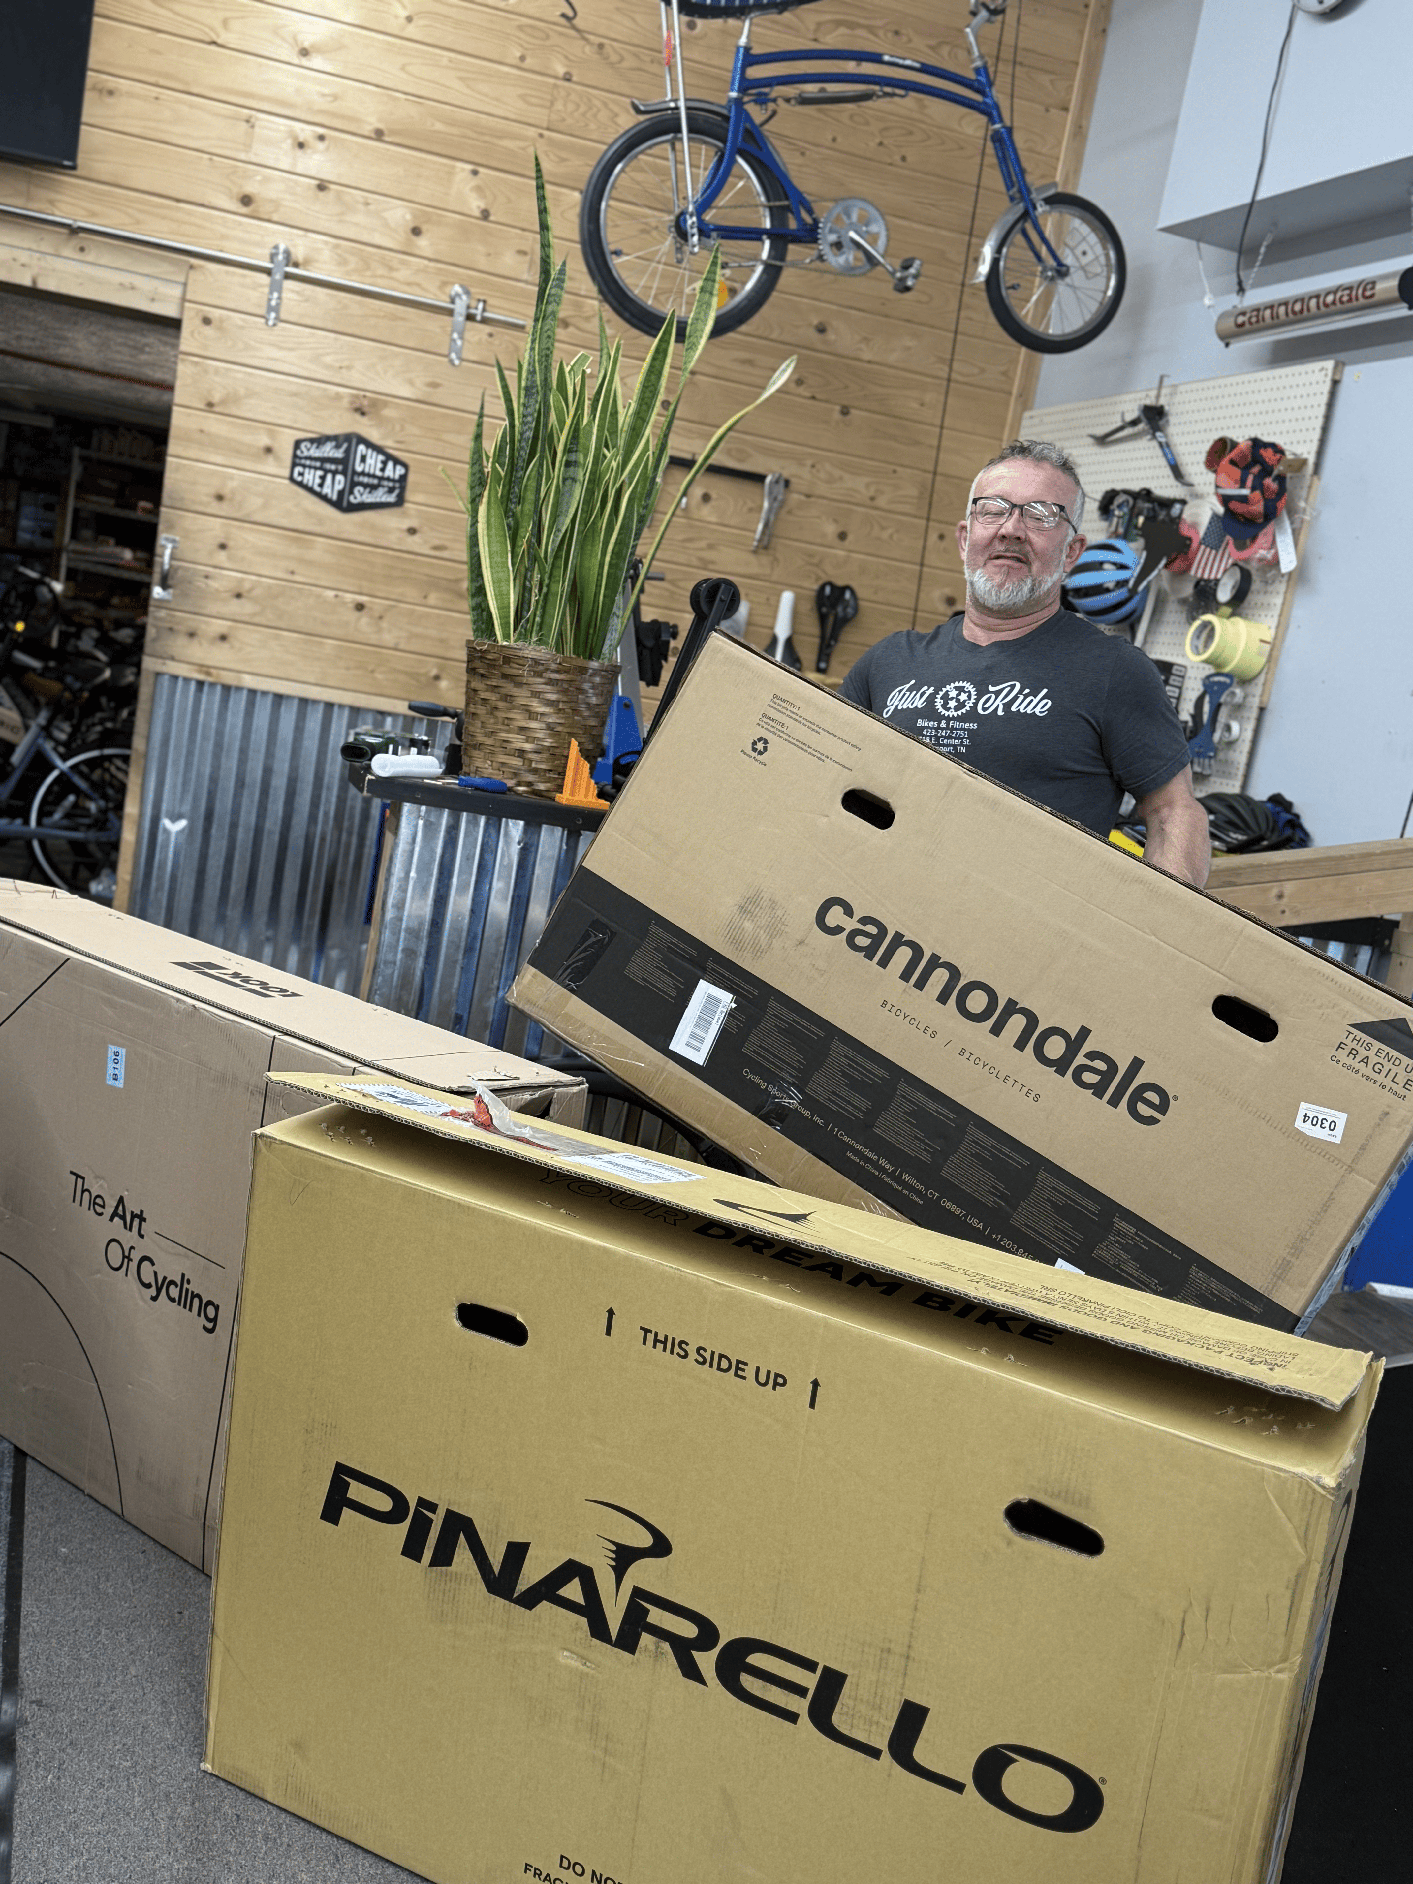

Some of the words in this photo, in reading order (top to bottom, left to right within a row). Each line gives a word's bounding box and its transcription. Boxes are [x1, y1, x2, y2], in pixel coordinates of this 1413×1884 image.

[1234, 279, 1376, 329] cannondale
[296, 441, 349, 458] Skilled
[355, 443, 406, 480] CHEAP
[293, 466, 345, 501] CHEAP
[349, 486, 400, 504] Skilled
[883, 680, 934, 718] Just
[977, 681, 1052, 716] Ride
[916, 718, 938, 728] Bikes
[939, 720, 947, 728] &
[949, 720, 978, 729] Fitness
[922, 729, 968, 738] 423-247-2751
[815, 896, 1171, 1127] cannondale
[880, 999, 938, 1039] BICYCLES
[958, 1047, 1041, 1103] BICYCLETTES
[1335, 1042, 1413, 1091] FRAGILE
[1344, 1030, 1373, 1052] THIS
[1374, 1047, 1402, 1067] END
[1404, 1063, 1413, 1074] U
[1330, 1054, 1341, 1065] Ce
[1361, 1072, 1378, 1085] vers
[1388, 1086, 1407, 1101] haut
[1302, 1112, 1337, 1132] 0304
[742, 1068, 767, 1089] Cycling
[767, 1084, 790, 1100] Sports
[837, 1130, 878, 1161] Cannondale
[879, 1156, 895, 1173] Way
[901, 1172, 925, 1194] Wilton,
[927, 1189, 940, 1200] CT
[966, 1214, 984, 1230] USA
[70, 1170, 106, 1217] The
[108, 1195, 147, 1240] Art
[105, 1238, 135, 1277] Of
[137, 1255, 219, 1334] Cycling
[692, 1221, 904, 1297] DREAM
[912, 1291, 1064, 1345] BIKE
[639, 1326, 689, 1360] THIS
[694, 1346, 749, 1381] SIDE
[754, 1365, 788, 1392] UP
[523, 1862, 569, 1884] FRAG
[559, 1854, 585, 1877] DO
[590, 1869, 623, 1884] NO
